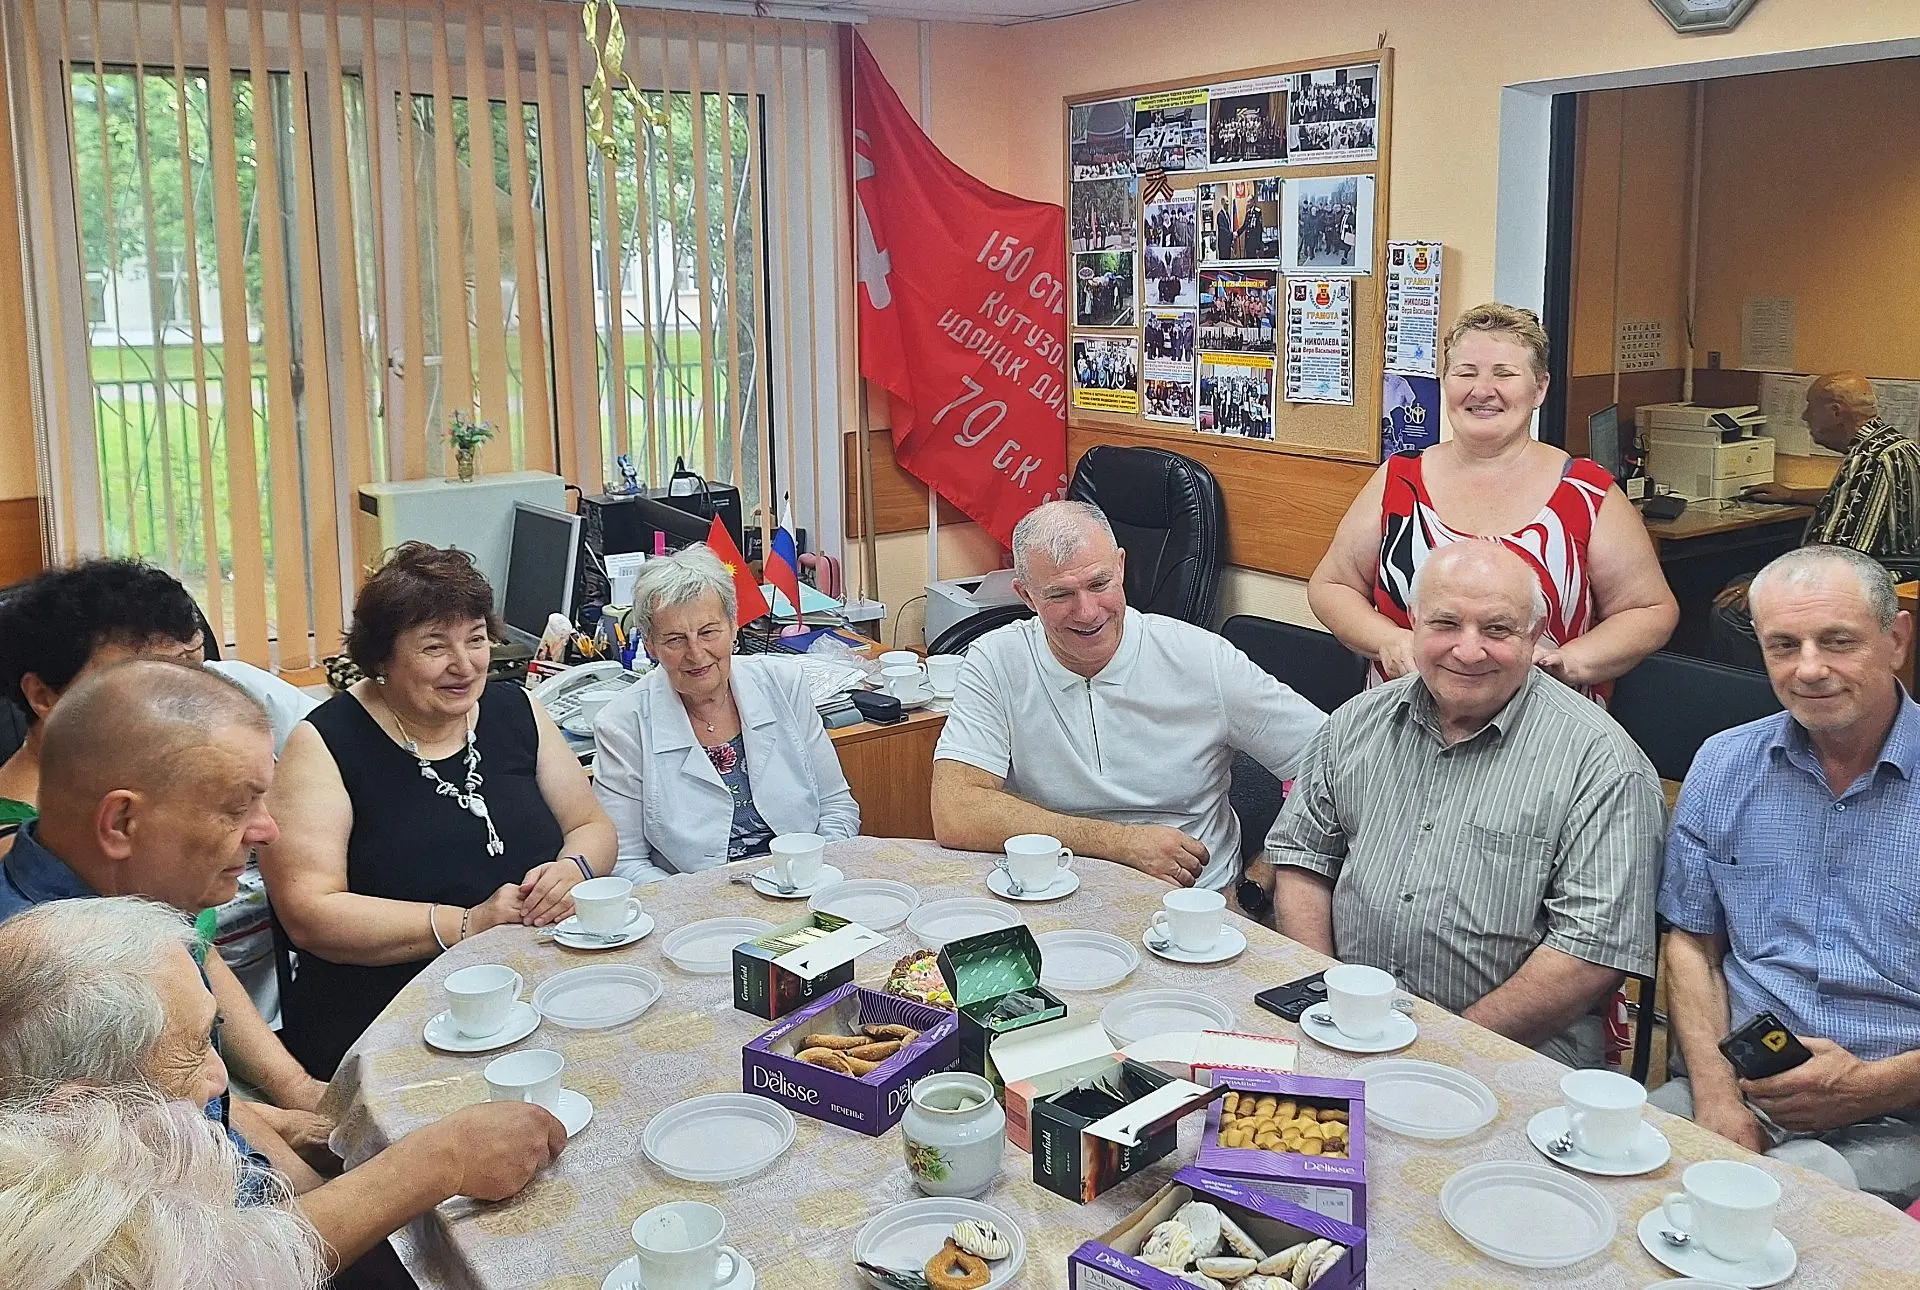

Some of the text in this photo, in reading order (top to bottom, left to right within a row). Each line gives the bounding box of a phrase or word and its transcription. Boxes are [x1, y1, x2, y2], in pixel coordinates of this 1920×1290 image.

[976, 230, 1064, 315] 150 СТ
[978, 290, 1065, 375] КУТУЗО
[1306, 311, 1339, 320] ГРАМОТА
[1302, 346, 1315, 355] Вера
[1304, 337, 1340, 346] НИКОЛАЕВА
[931, 375, 1008, 447] 79
[740, 964, 749, 1002] Greenfield
[830, 1103, 866, 1121] ПЕЧЕНЬЕ
[1041, 1129, 1053, 1175] Greenfield
